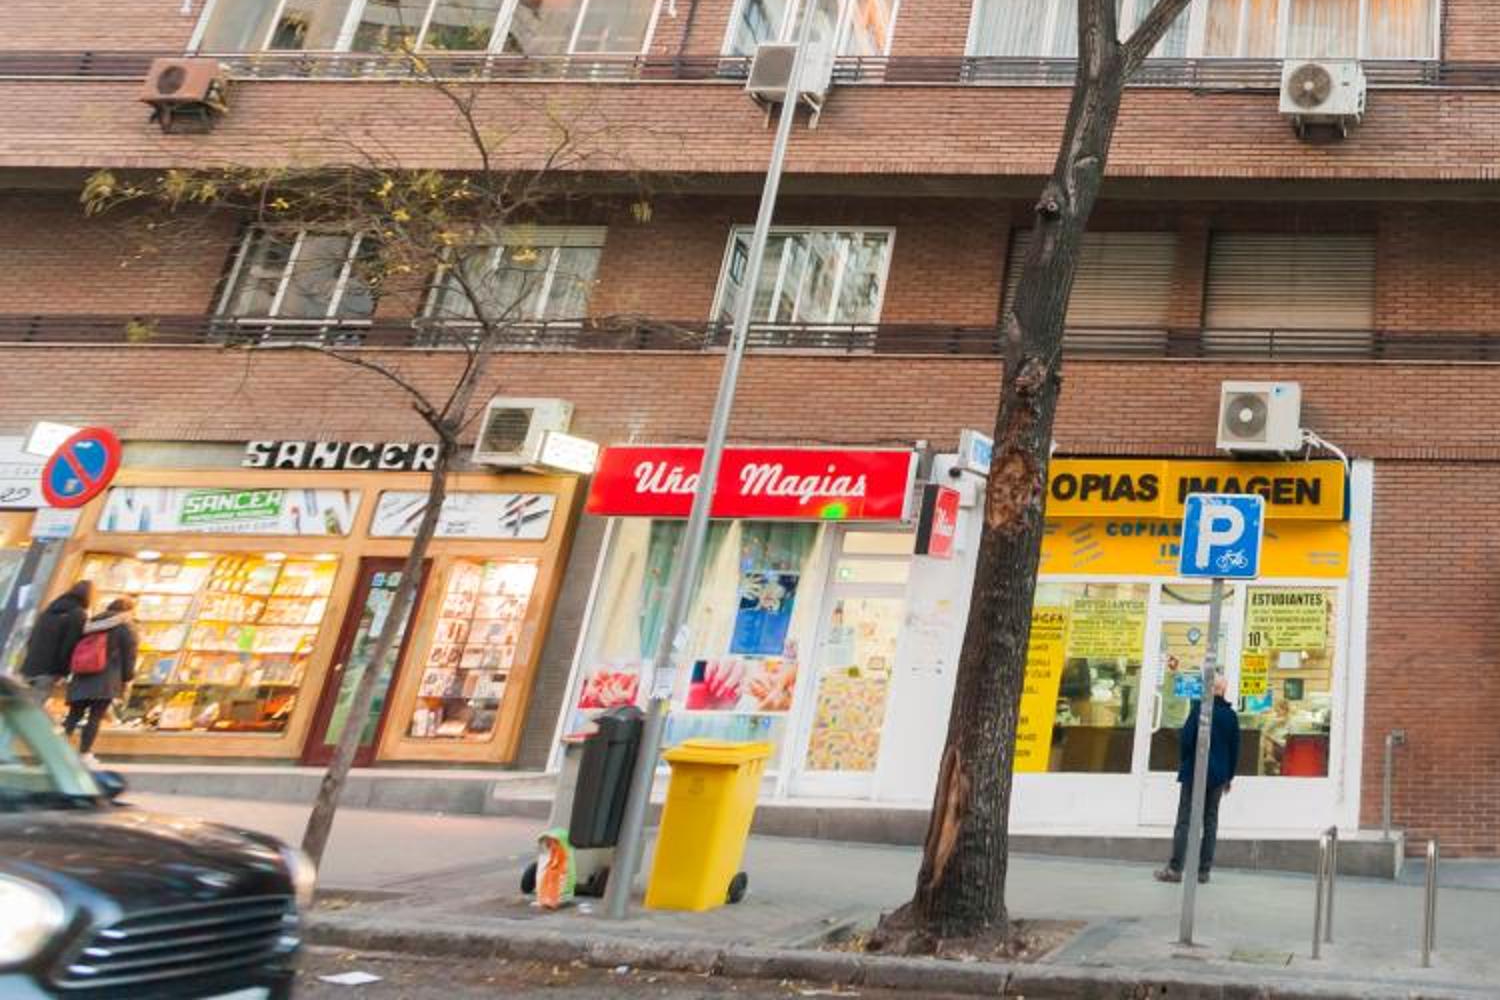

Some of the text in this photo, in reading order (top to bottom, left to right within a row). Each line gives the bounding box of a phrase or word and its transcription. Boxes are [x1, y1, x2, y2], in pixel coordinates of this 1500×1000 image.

[241, 440, 439, 470] SANCER
[633, 460, 867, 504] Uña Magias
[1051, 473, 1321, 505] OPIAS IMAGEN
[185, 489, 283, 513] SANCER
[1195, 504, 1246, 568] P
[1251, 593, 1323, 606] ESTUDIANTES
[1248, 631, 1261, 647] 10
